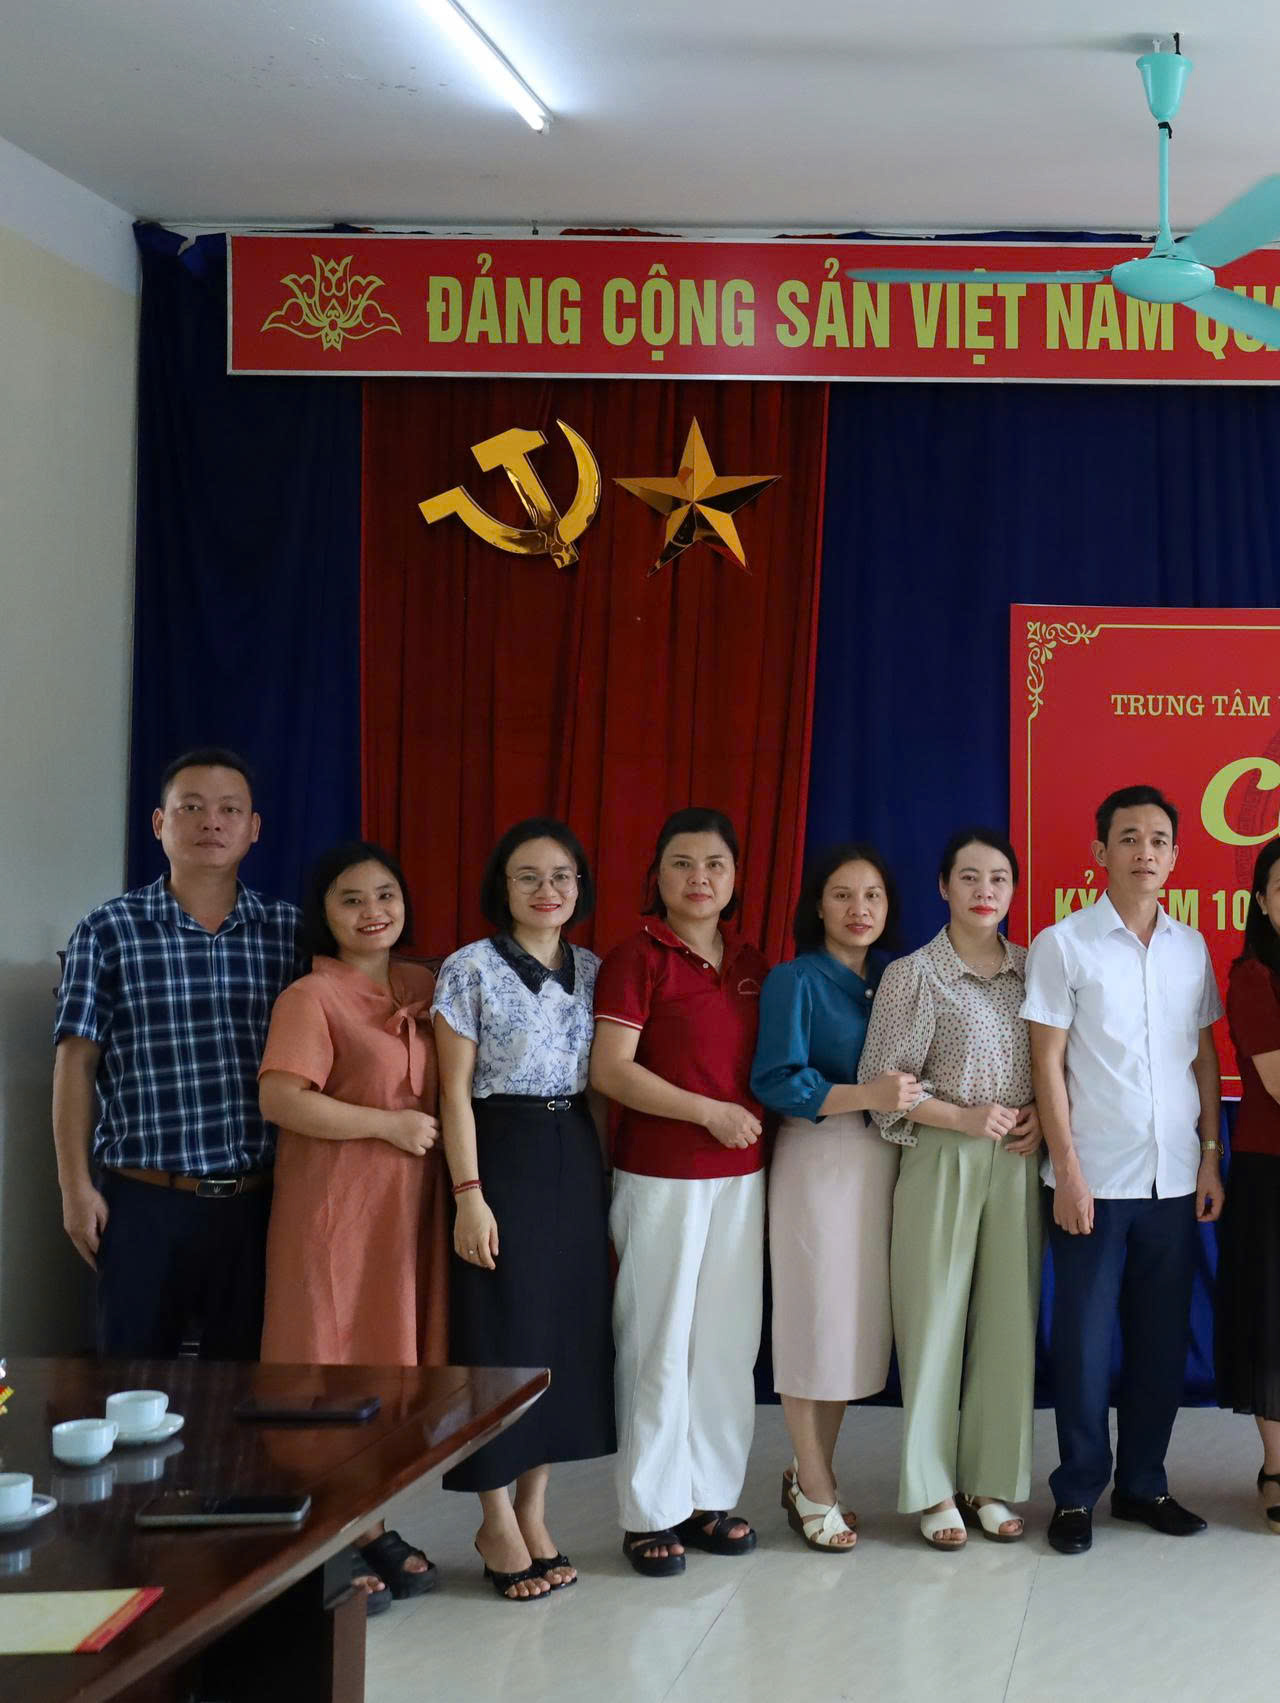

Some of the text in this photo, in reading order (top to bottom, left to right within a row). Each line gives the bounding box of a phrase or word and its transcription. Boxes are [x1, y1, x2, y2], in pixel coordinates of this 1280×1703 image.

[427, 253, 581, 345] ĐẢNG
[602, 264, 756, 361] CỘNG
[776, 258, 889, 348] SẢN
[909, 268, 1026, 365] VIỆT
[1046, 283, 1174, 351] NAM
[1111, 694, 1205, 716] TRUNG
[1212, 689, 1271, 717] TÂM
[1212, 890, 1251, 931] 10
